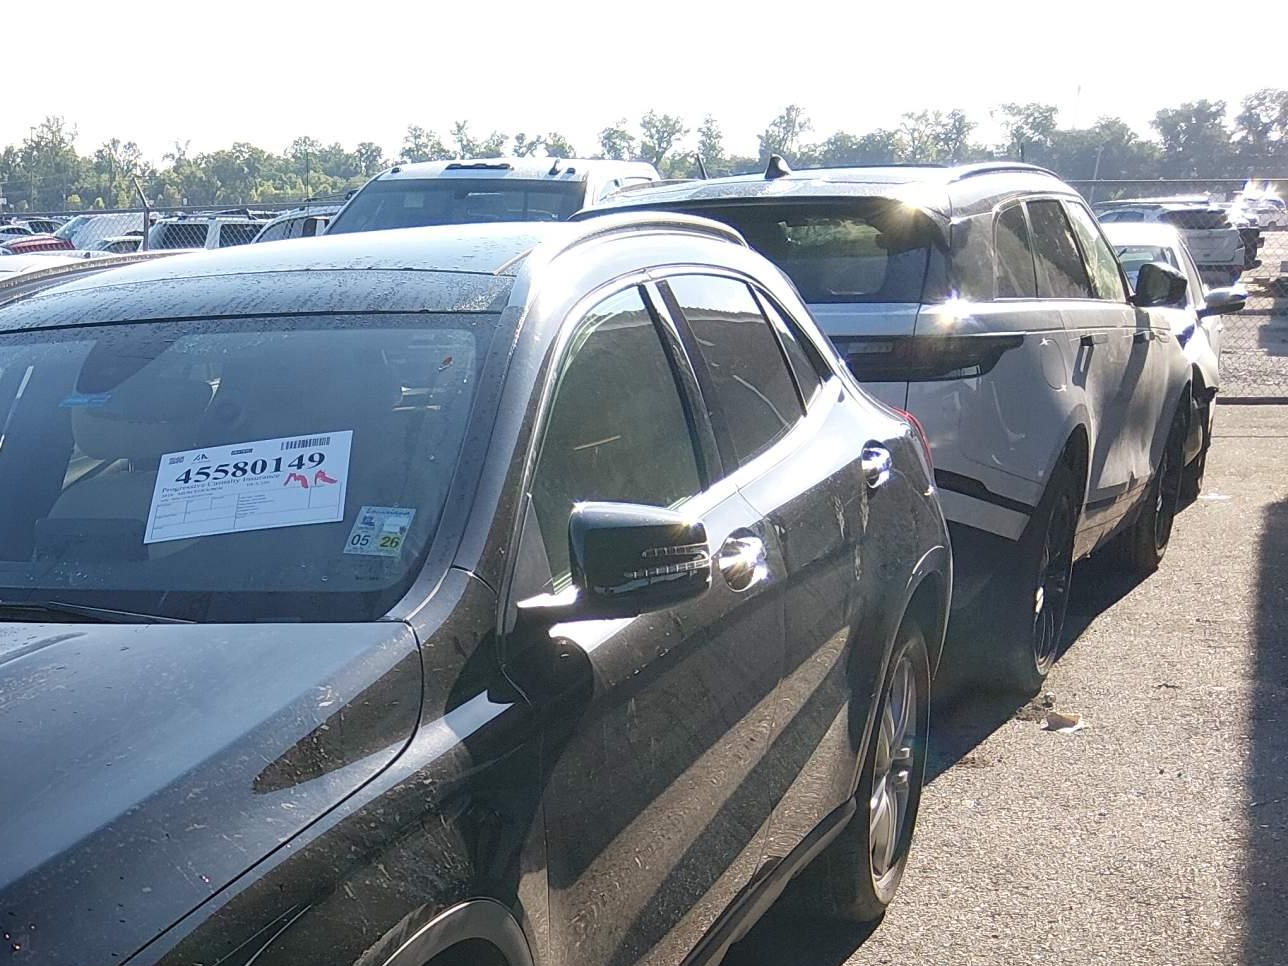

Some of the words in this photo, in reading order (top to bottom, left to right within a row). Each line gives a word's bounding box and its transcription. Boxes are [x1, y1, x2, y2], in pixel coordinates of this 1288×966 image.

[175, 452, 326, 485] 45580149
[351, 534, 371, 546] 05
[379, 536, 401, 549] 26
